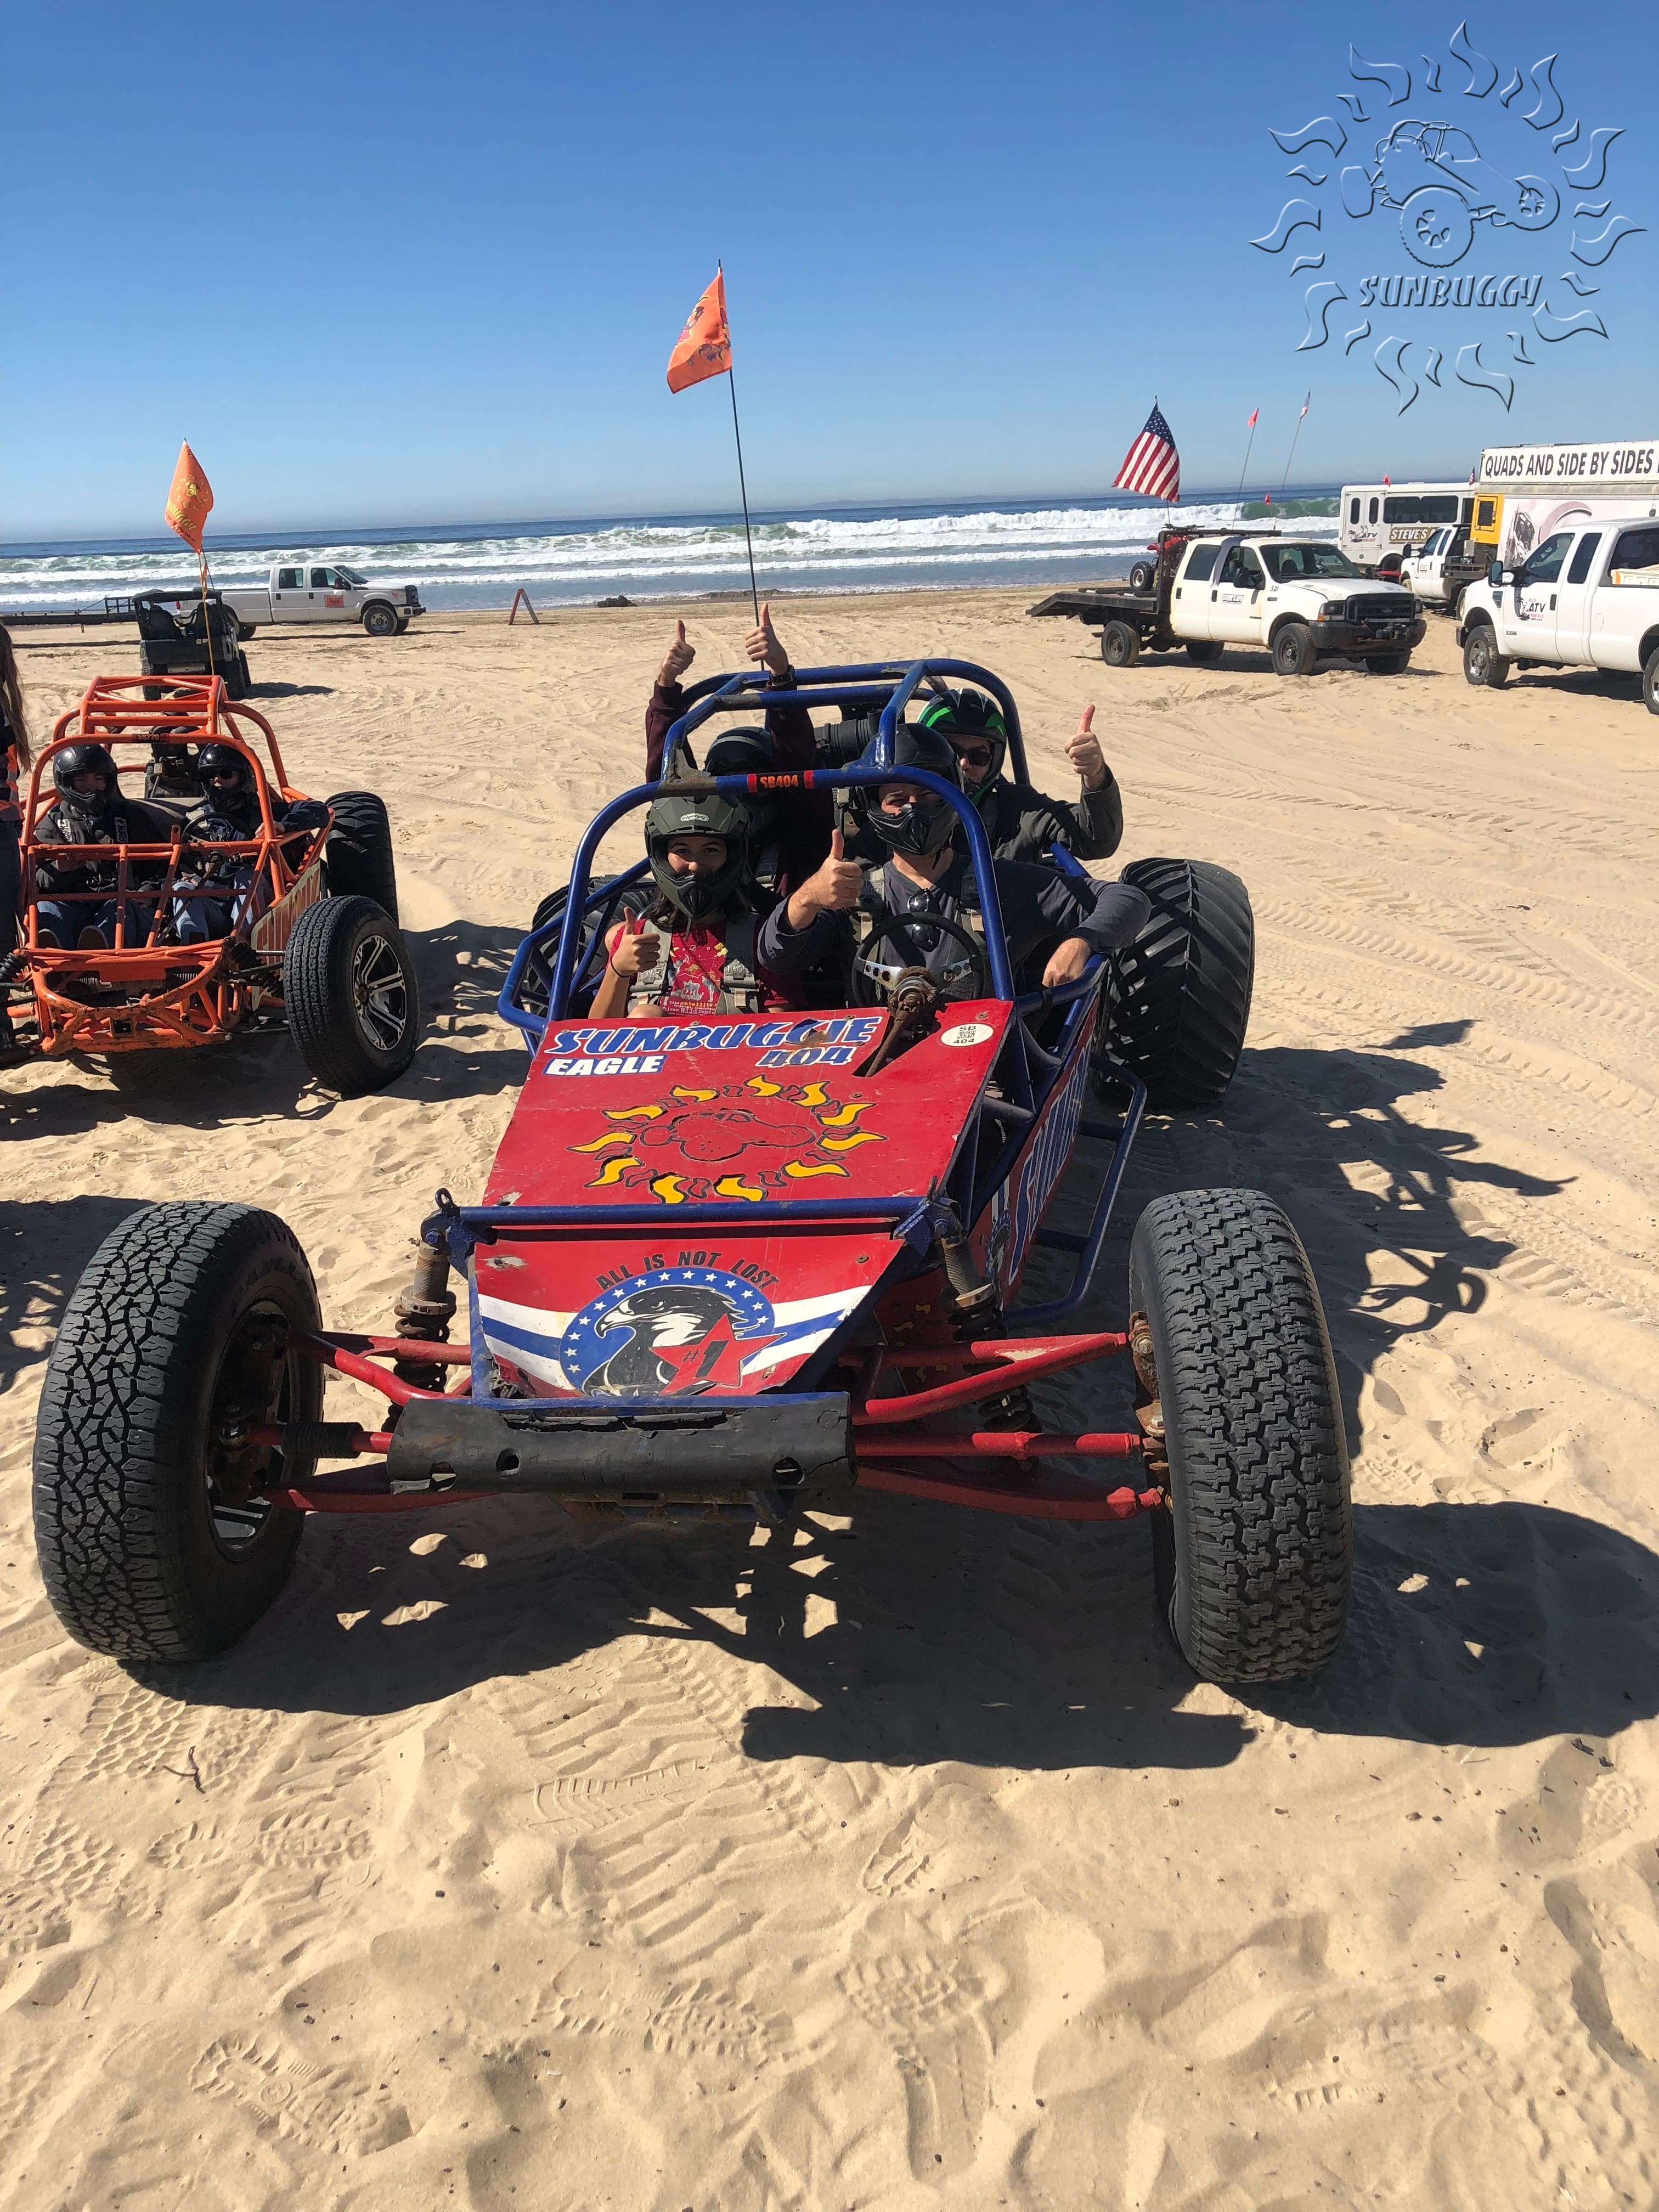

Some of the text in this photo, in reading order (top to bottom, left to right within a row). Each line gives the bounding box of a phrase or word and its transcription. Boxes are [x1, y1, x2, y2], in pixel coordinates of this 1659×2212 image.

[1485, 455, 1523, 477] QUADS
[1526, 454, 1554, 476] AND
[1557, 453, 1587, 476] SIDE
[1589, 451, 1610, 475] BY
[1611, 448, 1654, 475] SIDES
[1391, 528, 1427, 540] STEVE'S
[1528, 602, 1546, 612] ATV
[760, 775, 799, 788] SB404
[545, 1055, 664, 1075] EAGLE
[755, 1046, 857, 1068] 404
[596, 1250, 780, 1290] ALL IS NOT LOST
